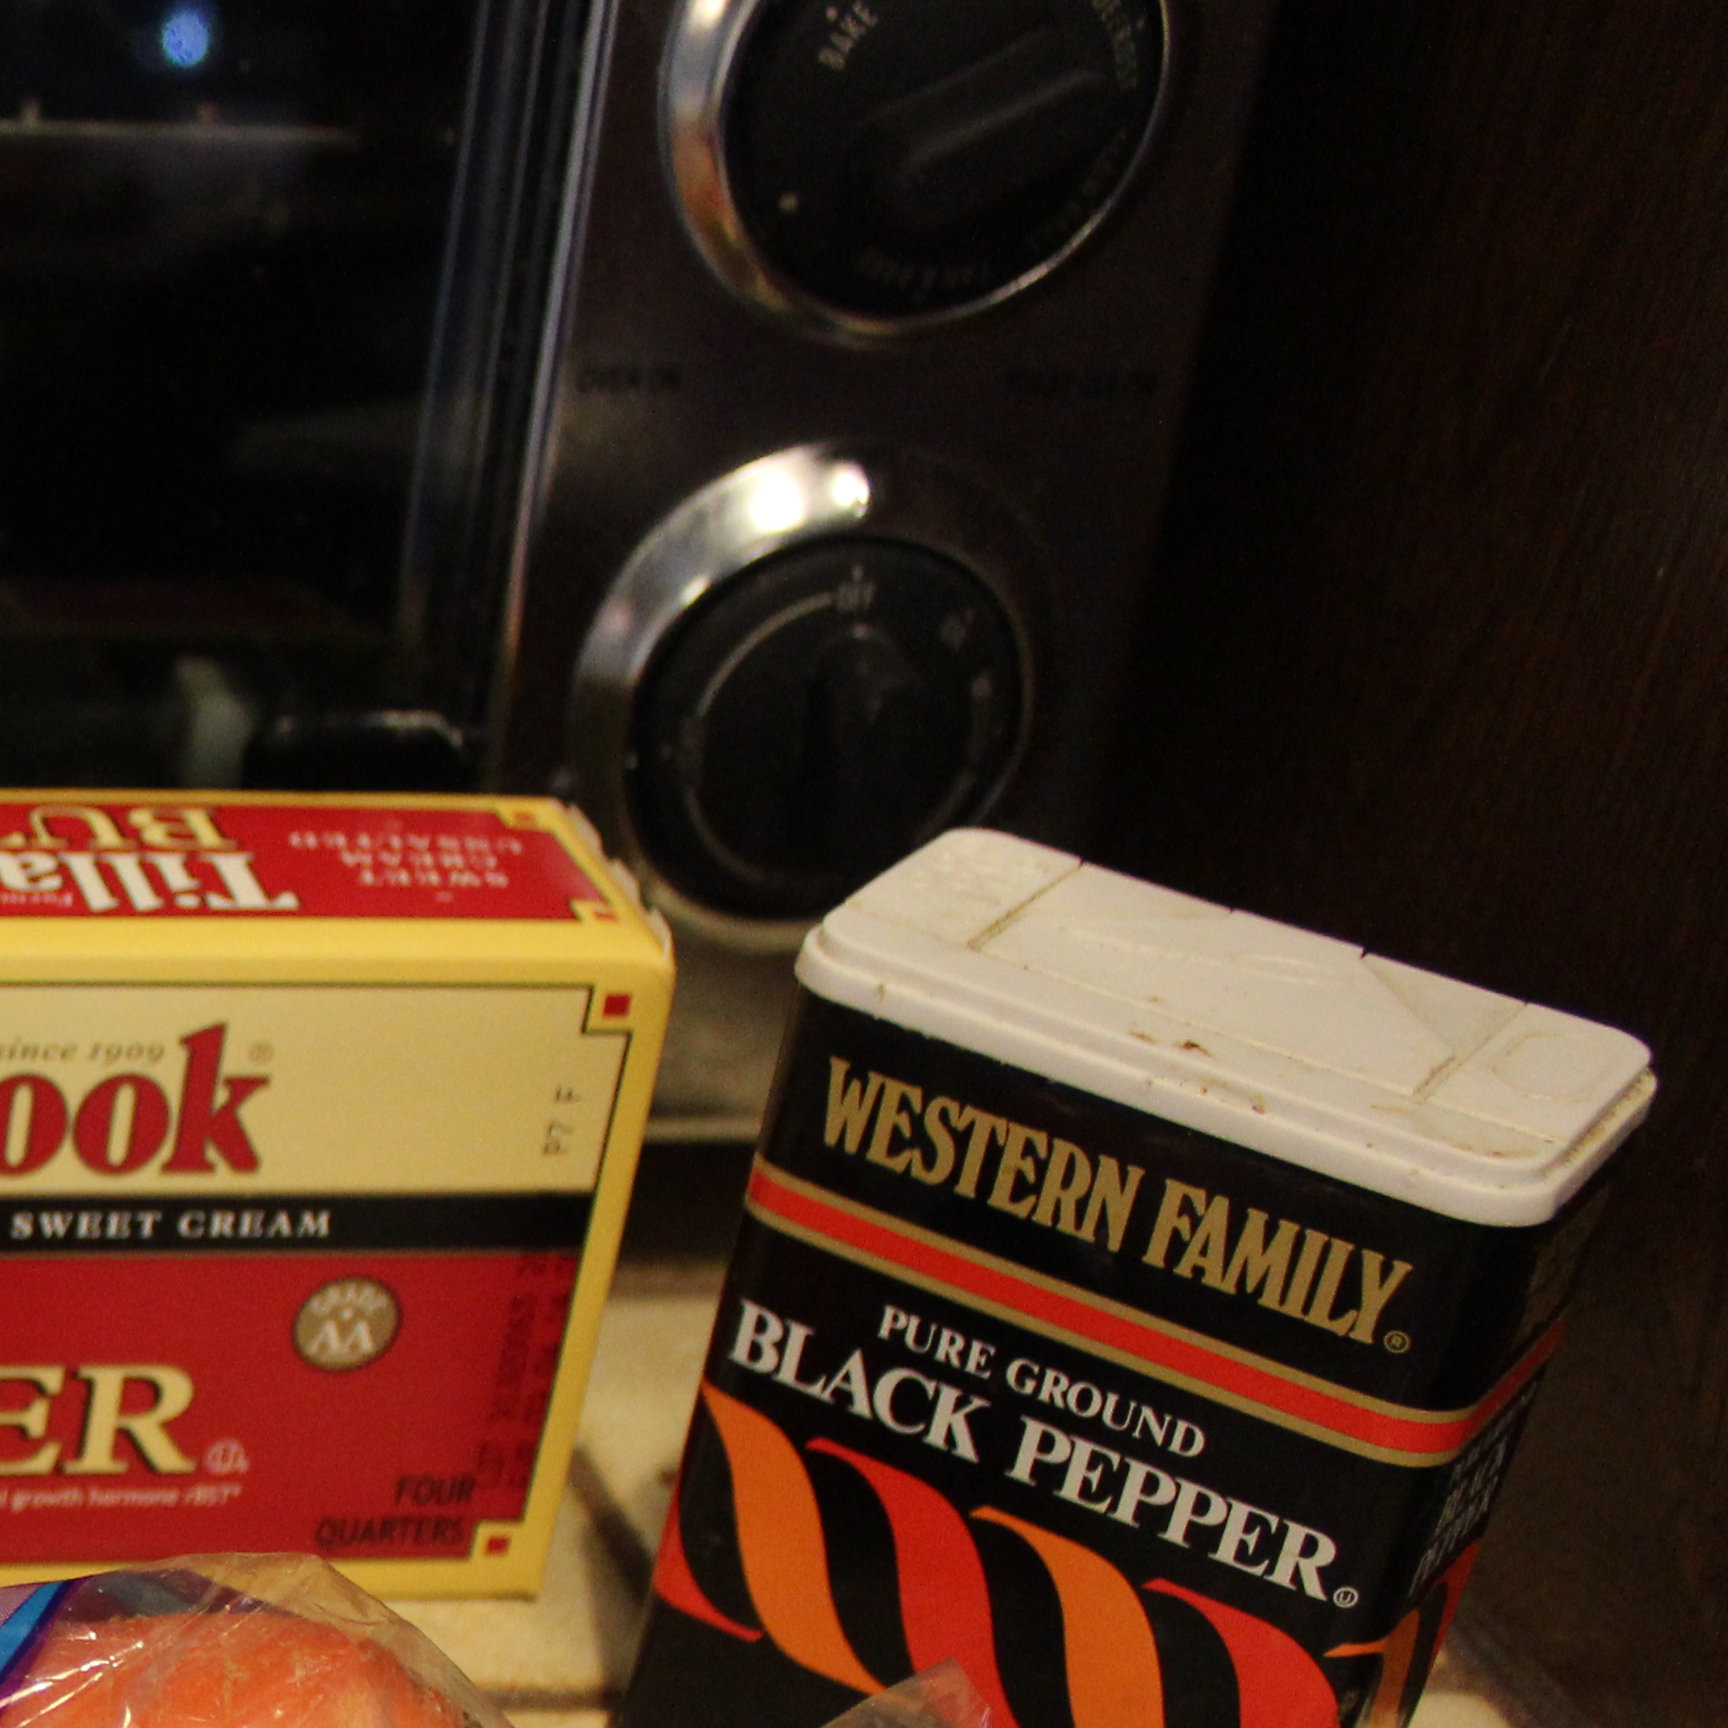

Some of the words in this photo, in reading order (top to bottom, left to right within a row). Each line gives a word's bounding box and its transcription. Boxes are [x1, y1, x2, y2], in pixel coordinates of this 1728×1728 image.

[87, 1040, 166, 1067] 1909
[824, 1055, 1144, 1252] WESTERN
[1142, 1180, 1414, 1345] FAMILY
[9, 1209, 162, 1241] SWEET
[178, 1208, 331, 1239] CREAM
[878, 1305, 992, 1380] PURE
[1005, 1358, 1206, 1459] GROUND
[728, 1301, 990, 1464] BLACK
[1005, 1414, 1339, 1603] PEPPER
[396, 1474, 476, 1505] FOUR
[315, 1516, 466, 1547] QUARTERS
